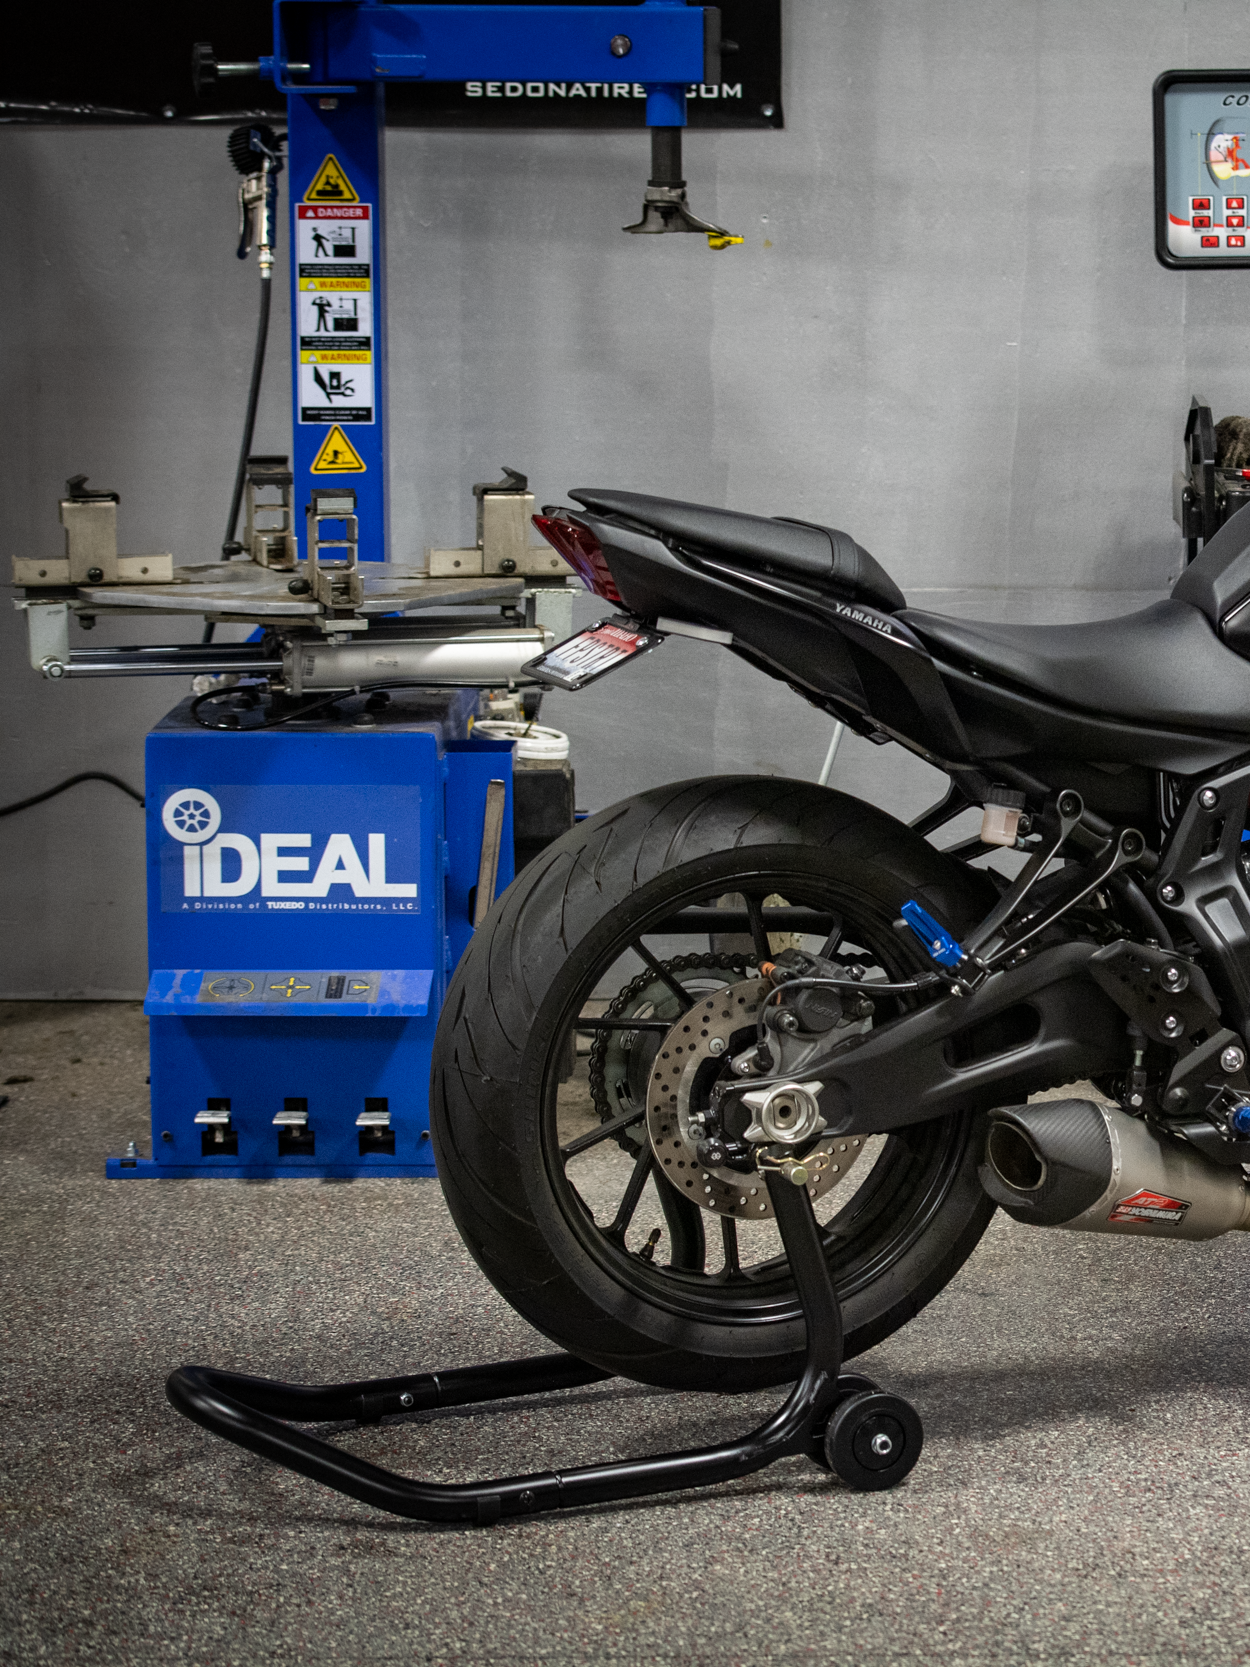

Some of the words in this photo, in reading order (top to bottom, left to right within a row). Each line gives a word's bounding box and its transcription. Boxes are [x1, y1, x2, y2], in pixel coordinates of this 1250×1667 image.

[317, 207, 363, 218] DANGER
[319, 280, 367, 290] WARNING
[320, 353, 368, 362] WARNING
[835, 603, 892, 634] YAMAHA
[194, 901, 243, 910] Division
[248, 902, 260, 910] of
[266, 901, 305, 910] TUXEDO
